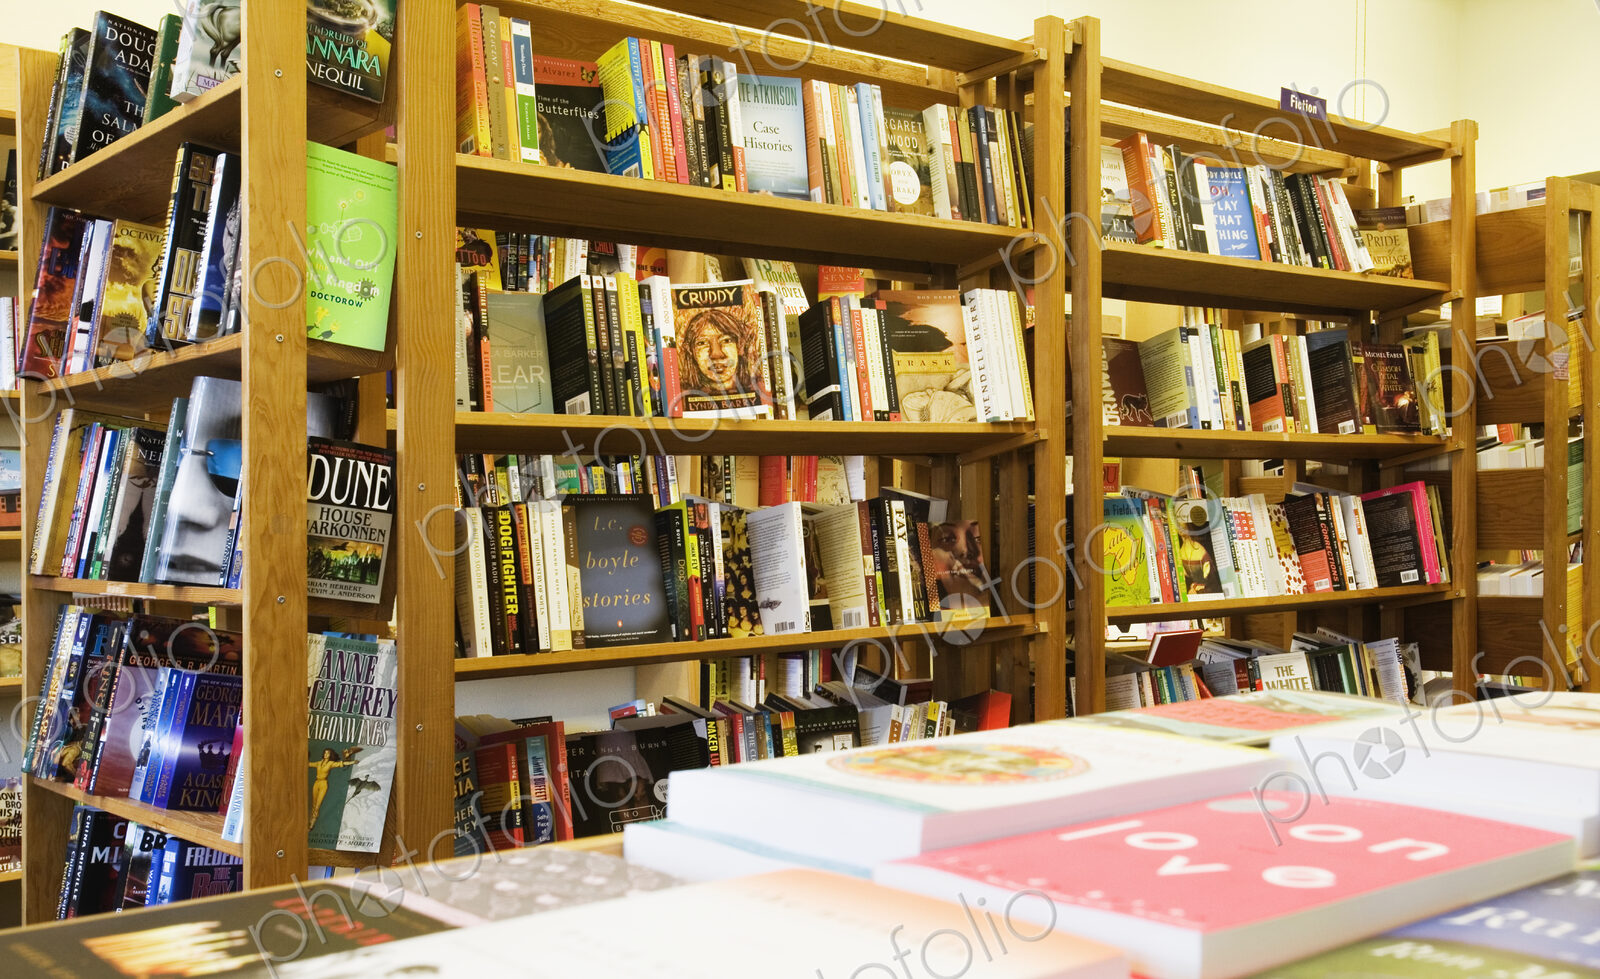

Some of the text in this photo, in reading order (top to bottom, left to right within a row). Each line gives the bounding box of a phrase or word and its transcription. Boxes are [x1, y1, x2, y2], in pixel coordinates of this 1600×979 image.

[488, 20, 500, 67] CRESCENT
[630, 41, 638, 57] TEN
[307, 61, 364, 91] NEQUIL
[542, 66, 578, 78] Alvarez
[537, 95, 550, 103] Time
[560, 97, 569, 105] the
[753, 84, 798, 106] ATKINSON
[1290, 93, 1318, 115] Fiction
[537, 102, 600, 120] Butterflies
[753, 120, 780, 135] Case
[92, 130, 115, 145] OF
[686, 127, 696, 156] woman
[743, 136, 793, 153] Histories
[697, 123, 709, 173] ISABEL ALLENDE
[735, 148, 745, 172] Dorothy
[1219, 171, 1242, 180] DOYLE
[1169, 188, 1178, 207] Mask
[1157, 202, 1165, 220] IVAN
[1311, 187, 1327, 233] RIVER TEETH
[1366, 232, 1400, 248] PRIDE
[1369, 254, 1408, 265] ARTHAGE
[760, 269, 800, 284] LOOKING
[823, 273, 861, 282] SENSE
[310, 290, 364, 308] DOCTOROW
[478, 276, 488, 327] SEBASTIAN BARRY
[661, 288, 669, 308] LUCKY
[678, 287, 738, 305] CRUDDY
[775, 286, 804, 299] NOVEL
[584, 294, 596, 345] REGENERATION
[611, 308, 619, 328] GHOST
[613, 329, 621, 347] ROAD
[853, 311, 864, 350] ELIZABETH
[503, 349, 544, 359] BARKER
[629, 336, 641, 391] DOUBLE VISION
[895, 358, 952, 367] TRASK
[969, 295, 992, 416] WENDELL BERRY
[1371, 364, 1401, 372] CRIMSON
[593, 383, 601, 410] BARKER
[1379, 384, 1403, 392] WHITE
[619, 385, 627, 411] BARKER
[688, 398, 756, 411] LYNDA BARRY
[308, 453, 392, 512] DUNE
[319, 507, 373, 526] HOUSE
[1112, 504, 1142, 516] Fielding
[307, 518, 387, 542] ARKONNEN
[895, 509, 907, 543] FAY
[1234, 513, 1243, 538] FORD
[1240, 513, 1249, 538] FORD
[1248, 513, 1256, 541] FORD
[487, 511, 496, 560] TRANS-SISTER
[585, 549, 640, 575] boyle
[1320, 522, 1339, 583] CORRECTIONS
[521, 548, 530, 581] GENTLEMAN
[329, 582, 362, 592] HERBERT
[338, 590, 376, 600] ANDERSON
[573, 582, 581, 614] Sheltering
[582, 588, 651, 608] stories
[129, 654, 238, 676] GEORGE MARTIN
[317, 648, 379, 687] ANNE
[1273, 664, 1296, 679] THE
[1265, 677, 1310, 691] WHITE
[807, 722, 827, 730] COLD
[828, 723, 858, 731] CAPOTE
[631, 740, 668, 751] BURNS
[706, 721, 719, 752] NAKED
[184, 772, 193, 787] A
[532, 756, 547, 801] JIMMY BUFFETT
[623, 810, 640, 819] NO
[81, 815, 92, 848] CHINA
[347, 839, 374, 848] MORETA
[213, 867, 231, 881] THE
[144, 869, 155, 905] WALTER
